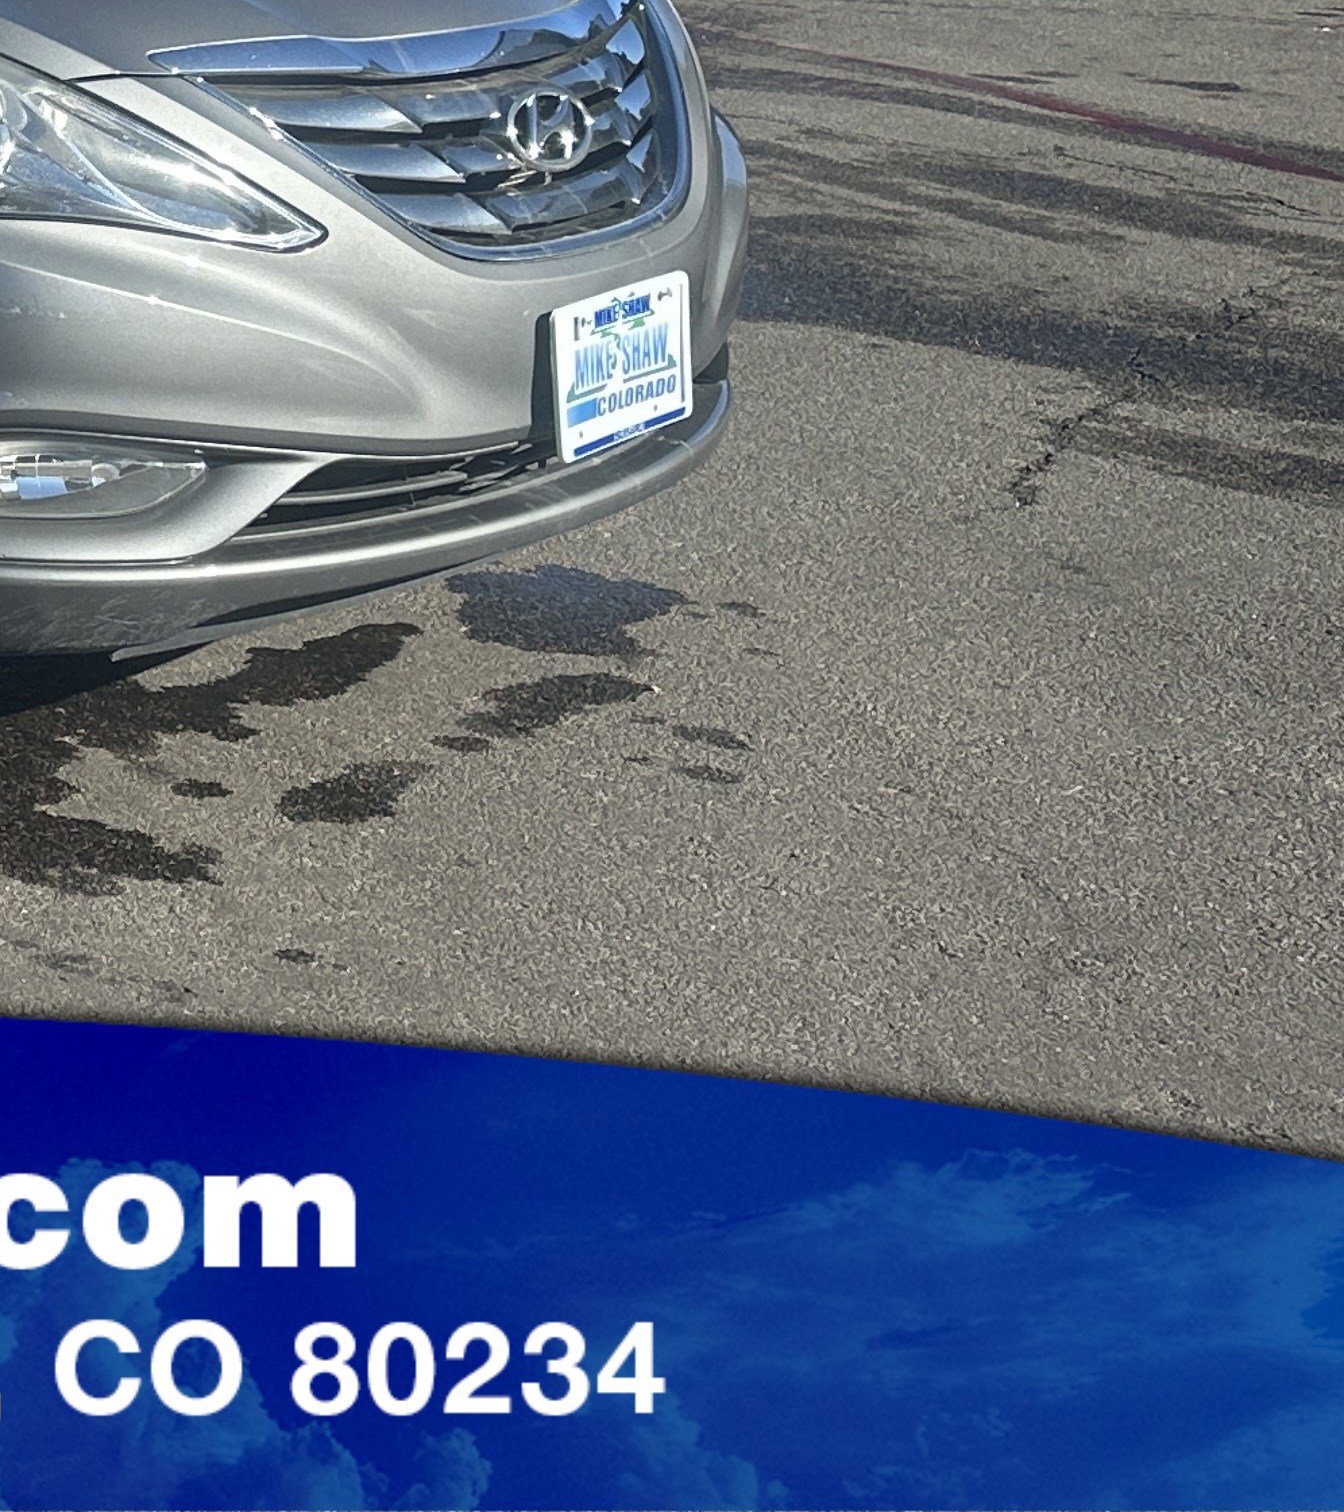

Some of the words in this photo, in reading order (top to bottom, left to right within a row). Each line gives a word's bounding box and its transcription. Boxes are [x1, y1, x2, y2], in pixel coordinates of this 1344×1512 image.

[575, 340, 614, 390] MIKE
[622, 321, 670, 374] SHAW
[596, 373, 677, 417] COLORADO
